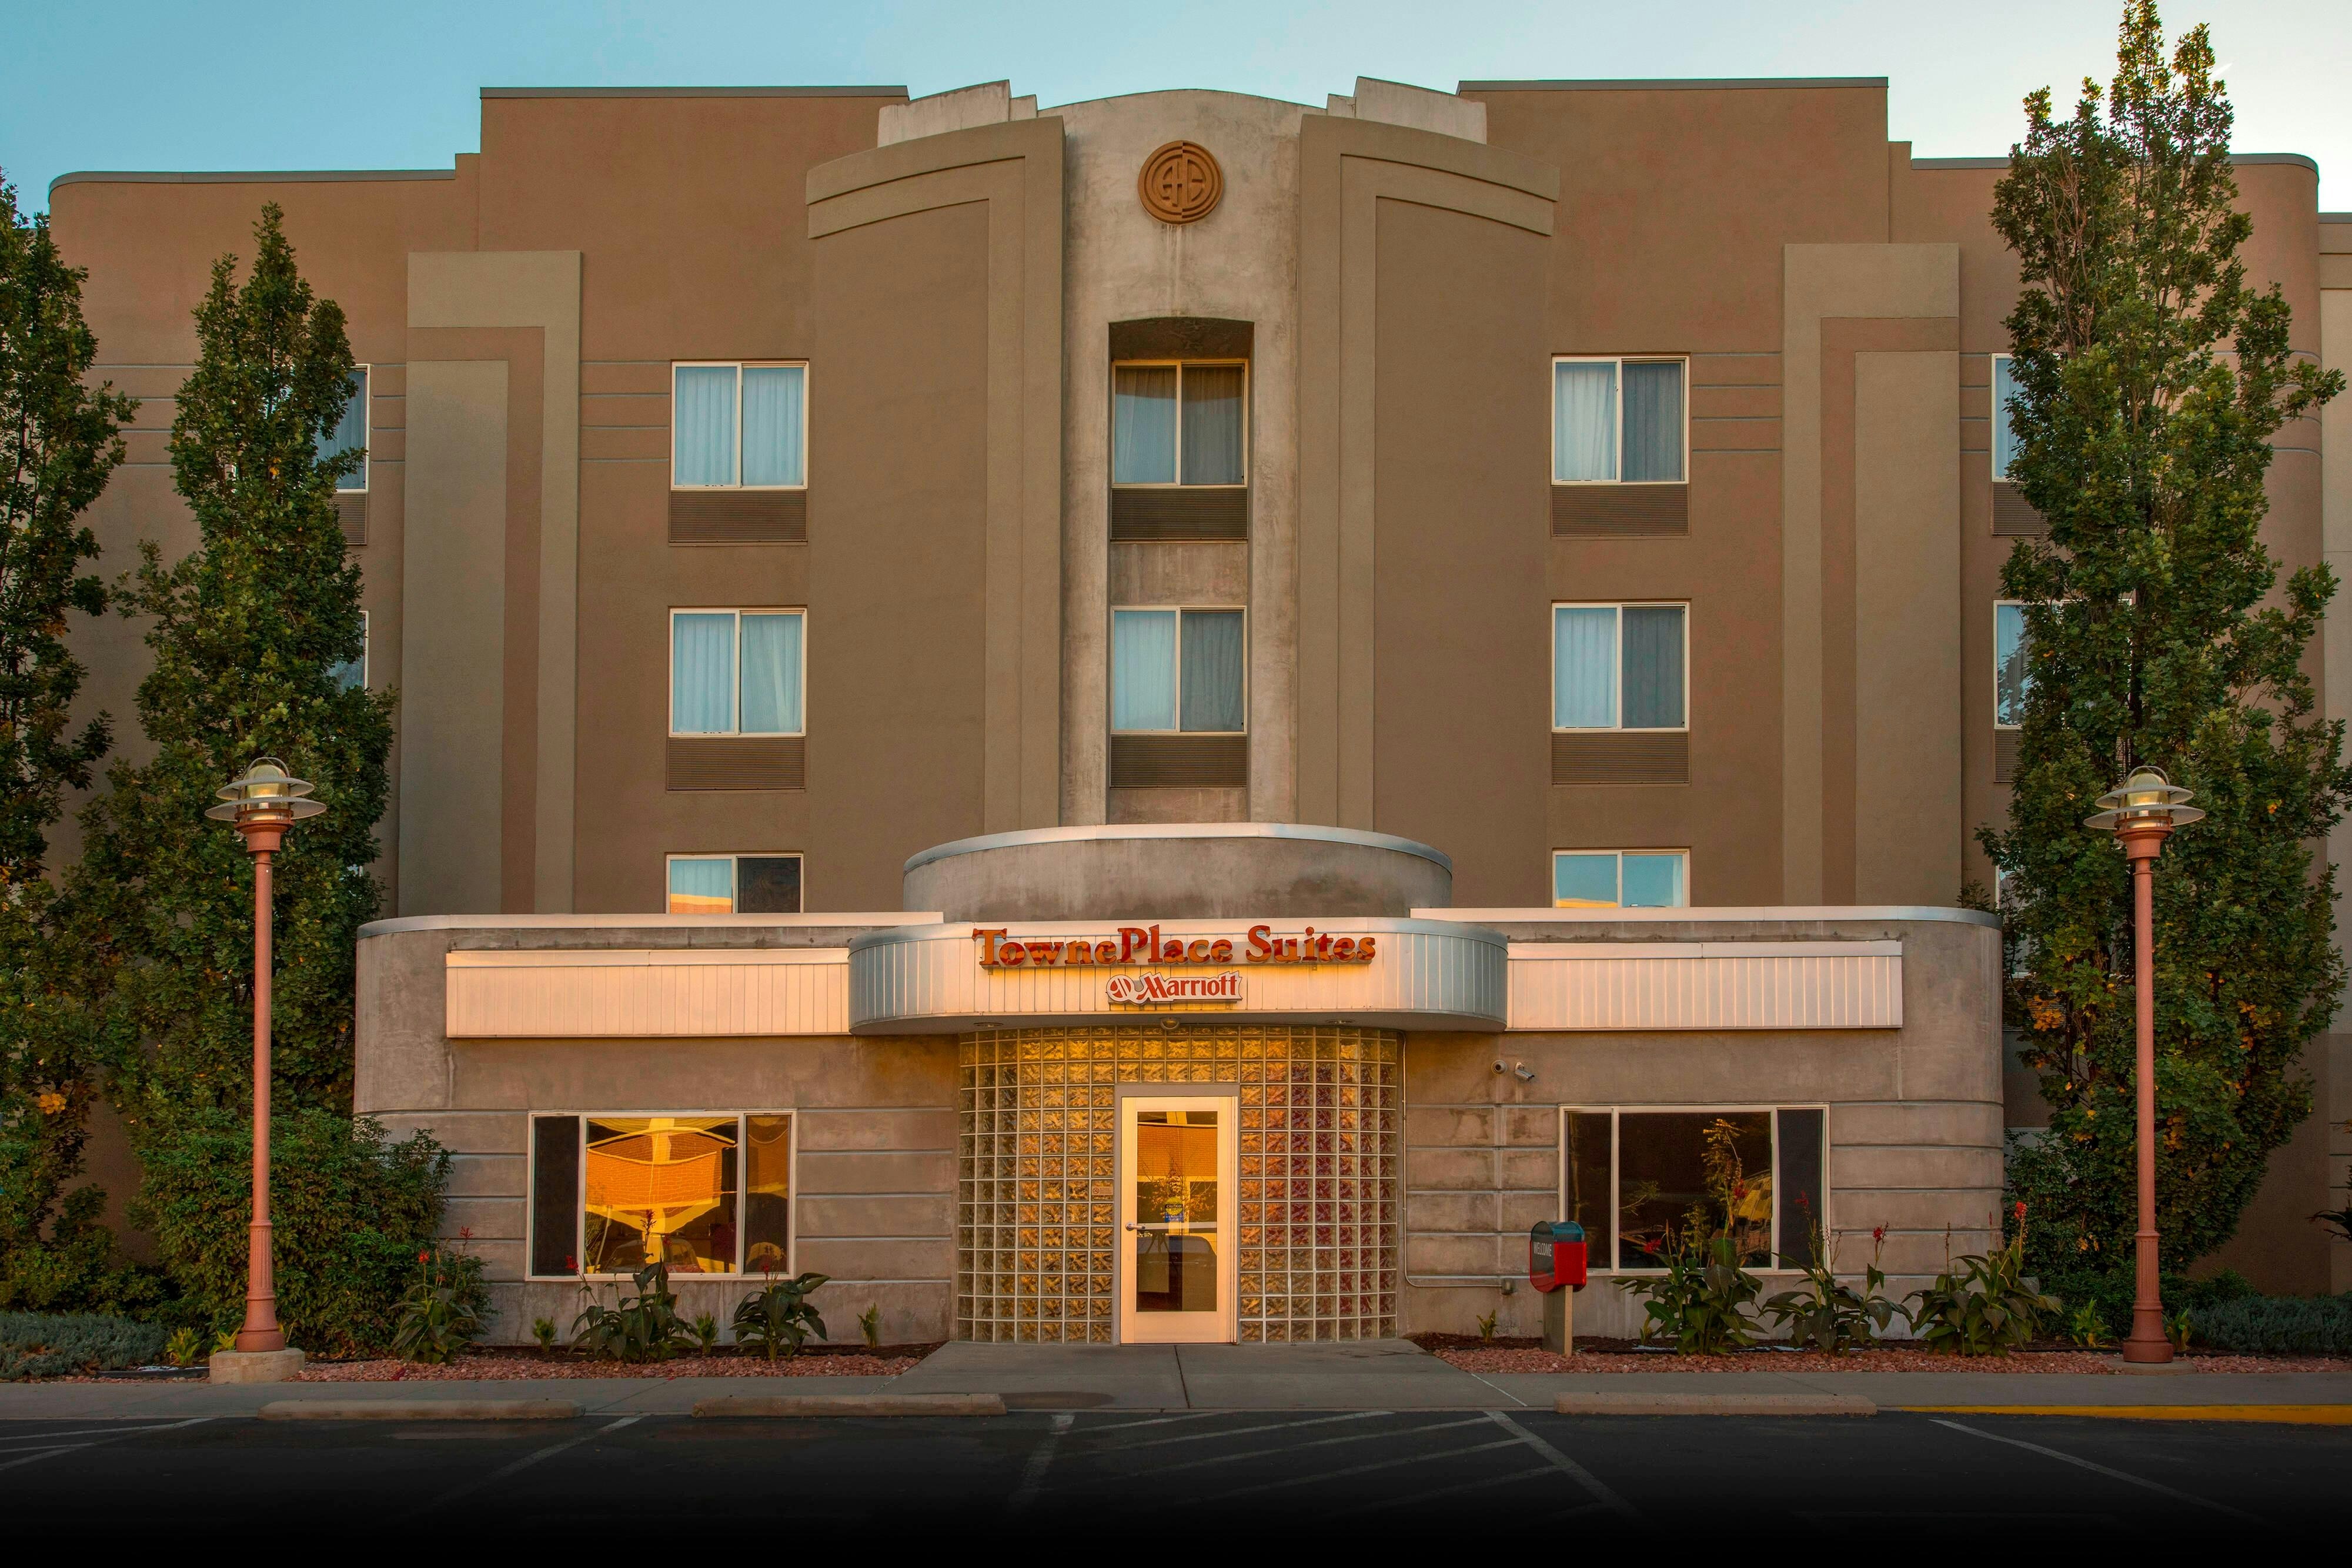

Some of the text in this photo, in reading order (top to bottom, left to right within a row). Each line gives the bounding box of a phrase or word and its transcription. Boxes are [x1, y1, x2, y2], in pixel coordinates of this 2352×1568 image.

[971, 924, 1376, 966] TownePlace Suites
[1136, 975, 1238, 1000] Marriott
[1533, 1242, 1552, 1257] WELCOME
